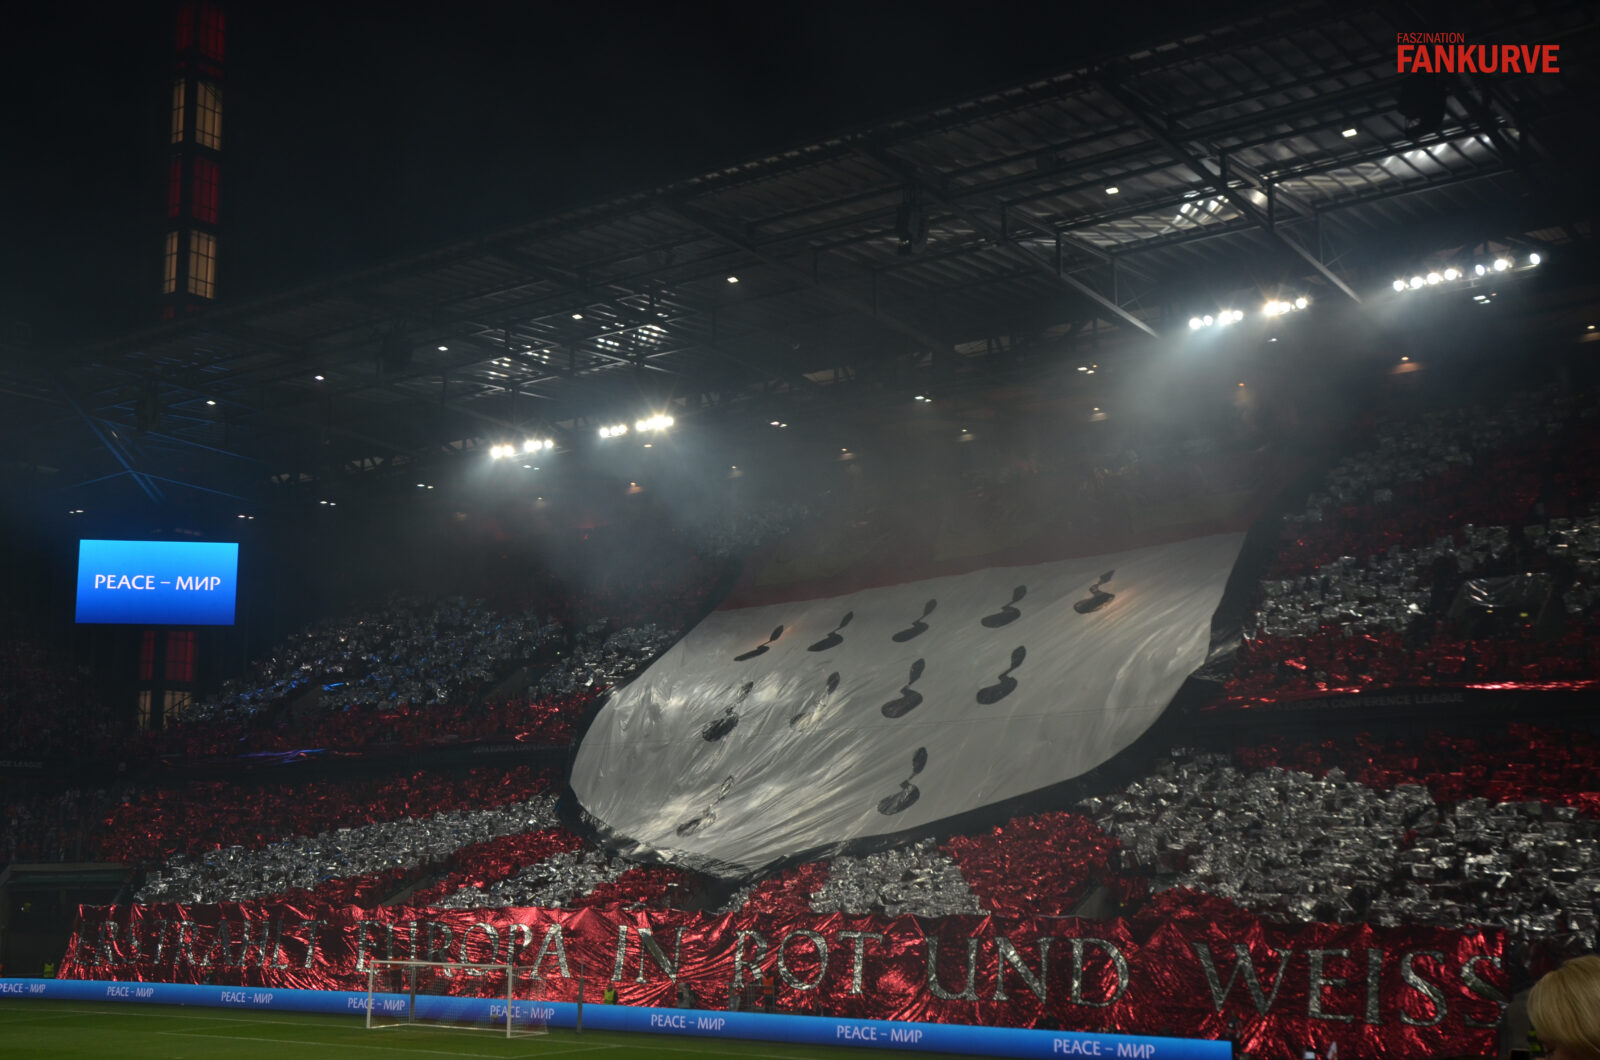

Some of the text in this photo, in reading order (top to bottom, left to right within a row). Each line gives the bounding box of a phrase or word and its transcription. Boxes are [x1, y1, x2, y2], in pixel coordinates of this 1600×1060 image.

[94, 574, 156, 590] PEACE
[175, 576, 221, 591] МИР
[1331, 695, 1412, 709] CONFERENCE
[1415, 693, 1464, 705] LEAGUE
[355, 920, 571, 980] EUROPA
[610, 924, 688, 985] IN
[733, 929, 884, 995] ROT
[922, 934, 1130, 1008] UND
[1191, 940, 1512, 1029] WEISS
[29, 984, 46, 993] МИР
[107, 986, 130, 997] PEACE
[135, 987, 154, 998] МИР
[220, 991, 246, 1004] PEACE
[253, 993, 274, 1004] МИР
[347, 997, 375, 1010] PEACE
[383, 999, 406, 1011] МИР
[490, 1005, 521, 1019] PEACE
[530, 1007, 555, 1020] МИР
[651, 1014, 687, 1029] PEACE
[697, 1017, 726, 1031] МИР
[836, 1025, 878, 1041] PEACE
[890, 1027, 923, 1043] МИР
[1053, 1038, 1102, 1056] PEACE
[1117, 1042, 1156, 1059] МИР
